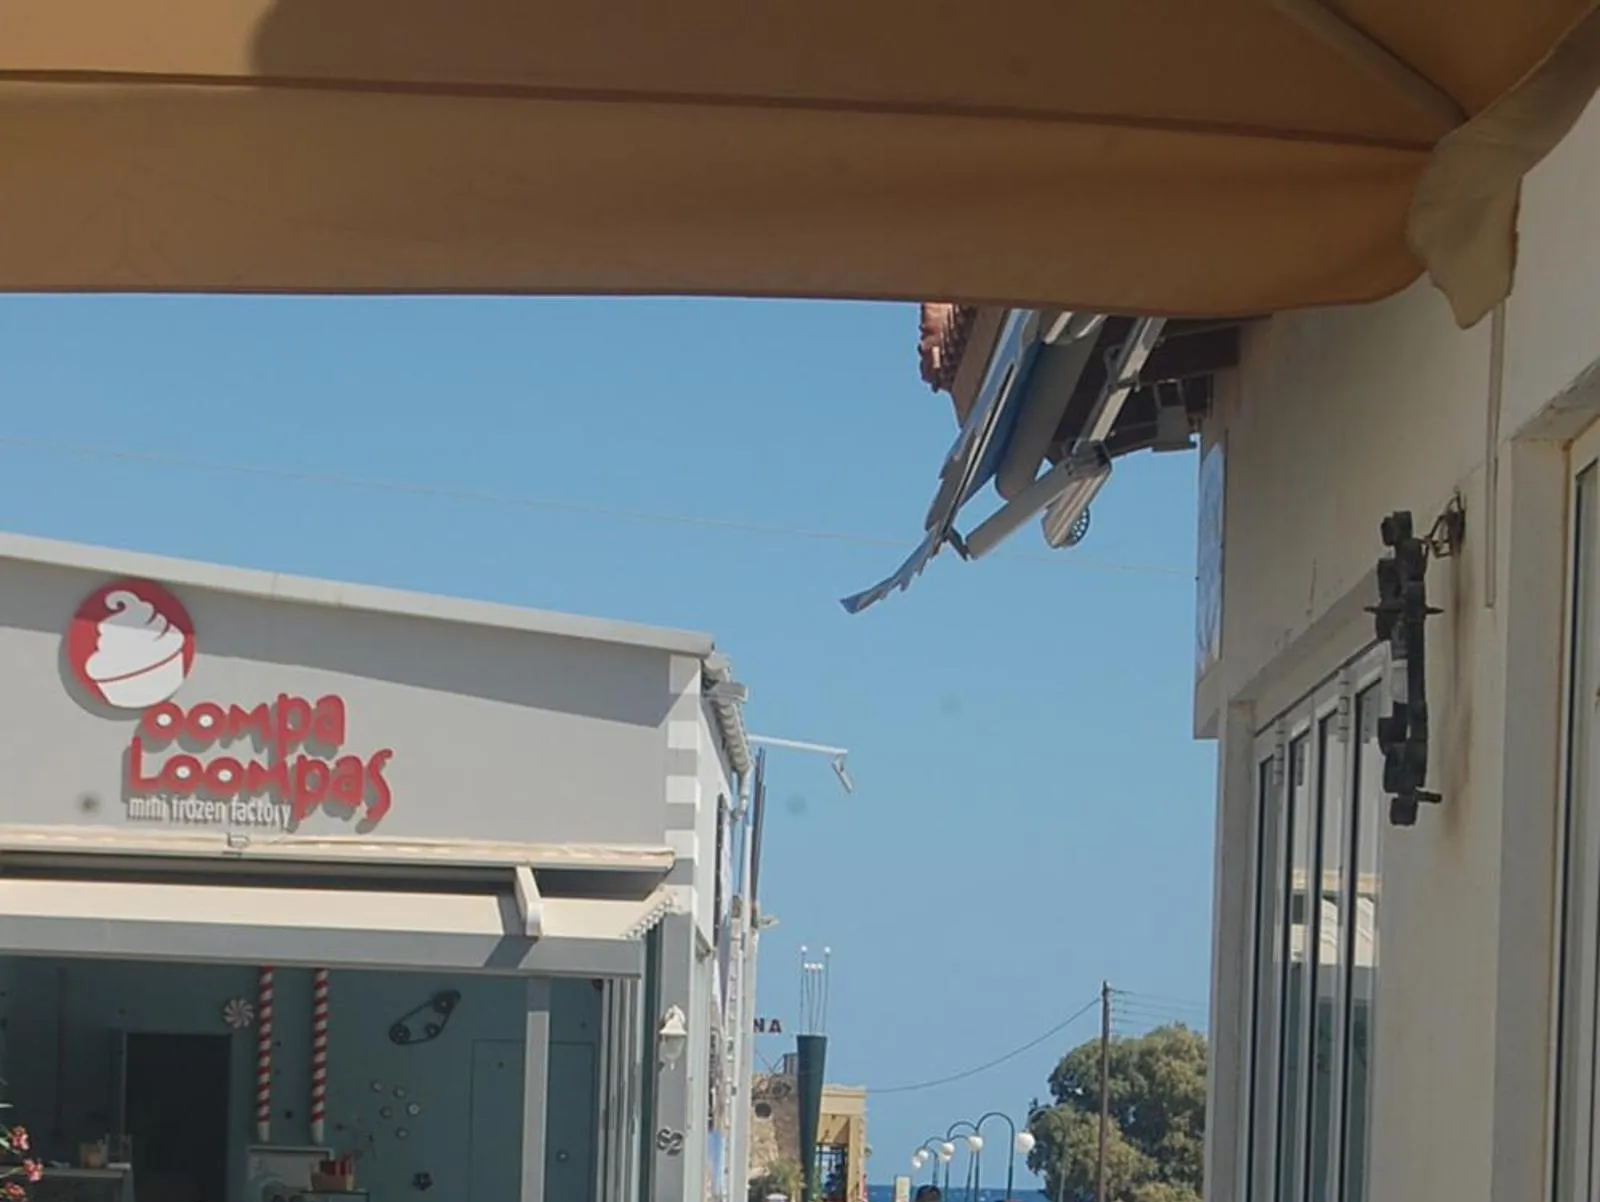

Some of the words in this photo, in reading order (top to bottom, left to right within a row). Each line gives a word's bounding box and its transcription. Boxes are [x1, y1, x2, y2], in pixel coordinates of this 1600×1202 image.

[128, 794, 169, 818] mini
[172, 794, 228, 822] frozen
[230, 792, 293, 828] factory
